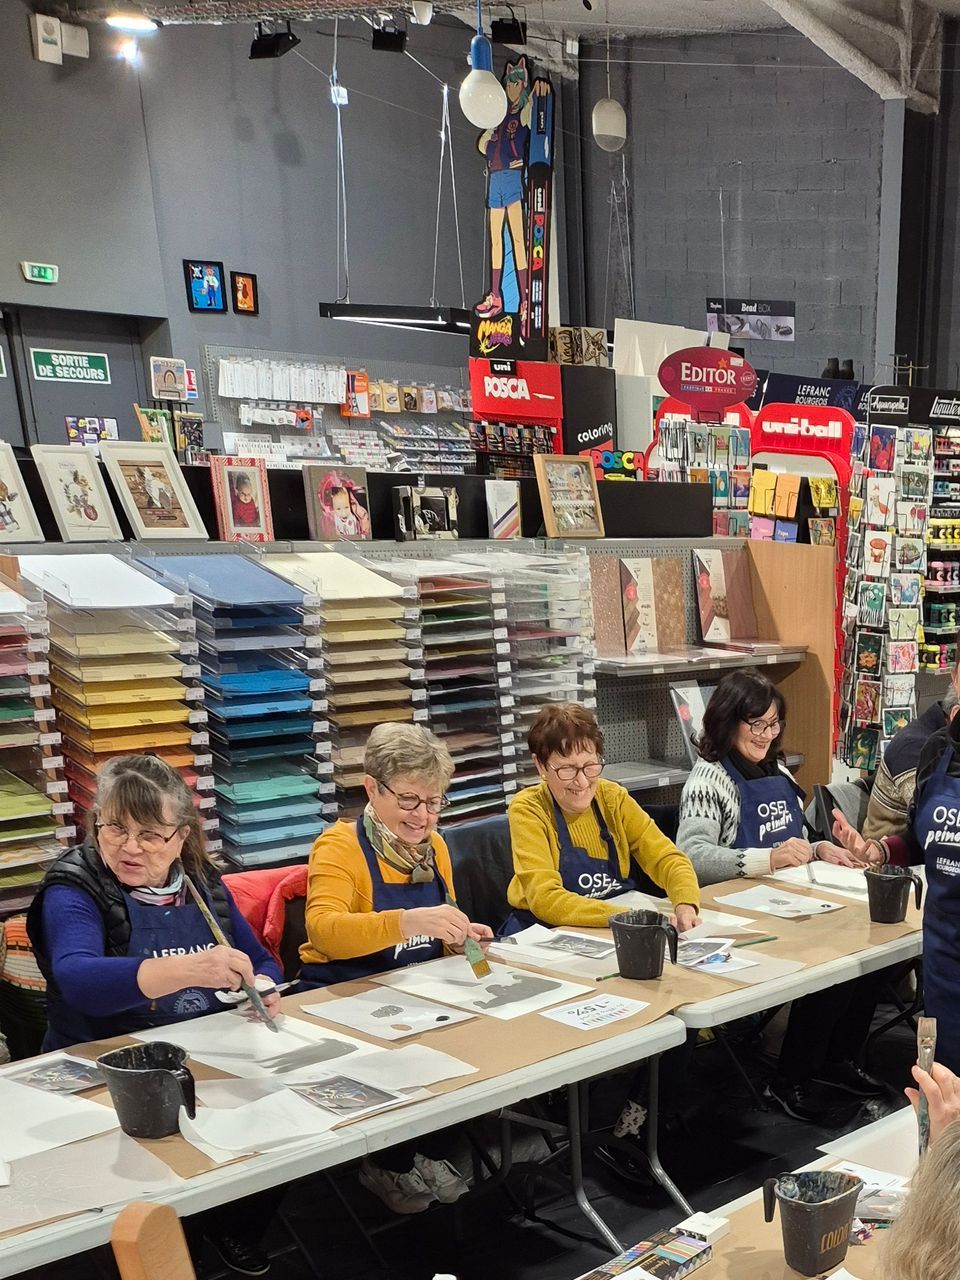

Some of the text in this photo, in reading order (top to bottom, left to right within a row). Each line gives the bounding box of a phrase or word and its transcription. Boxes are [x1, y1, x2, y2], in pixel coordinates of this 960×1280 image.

[532, 214, 544, 271] POSCA
[741, 303, 757, 313] Bead
[758, 304, 771, 313] BOX
[477, 320, 513, 342] MANGA
[51, 354, 89, 367] SORTIE
[493, 362, 511, 372] uni
[38, 365, 104, 380] DE SECOURS
[681, 362, 736, 385] EDITOR
[484, 376, 530, 400] POSCA
[797, 384, 831, 397] LEFRANC
[795, 395, 828, 406] BOURGEOIS
[577, 422, 613, 443] coloring
[594, 450, 645, 470] POSCA
[567, 1001, 610, 1017] -15%
